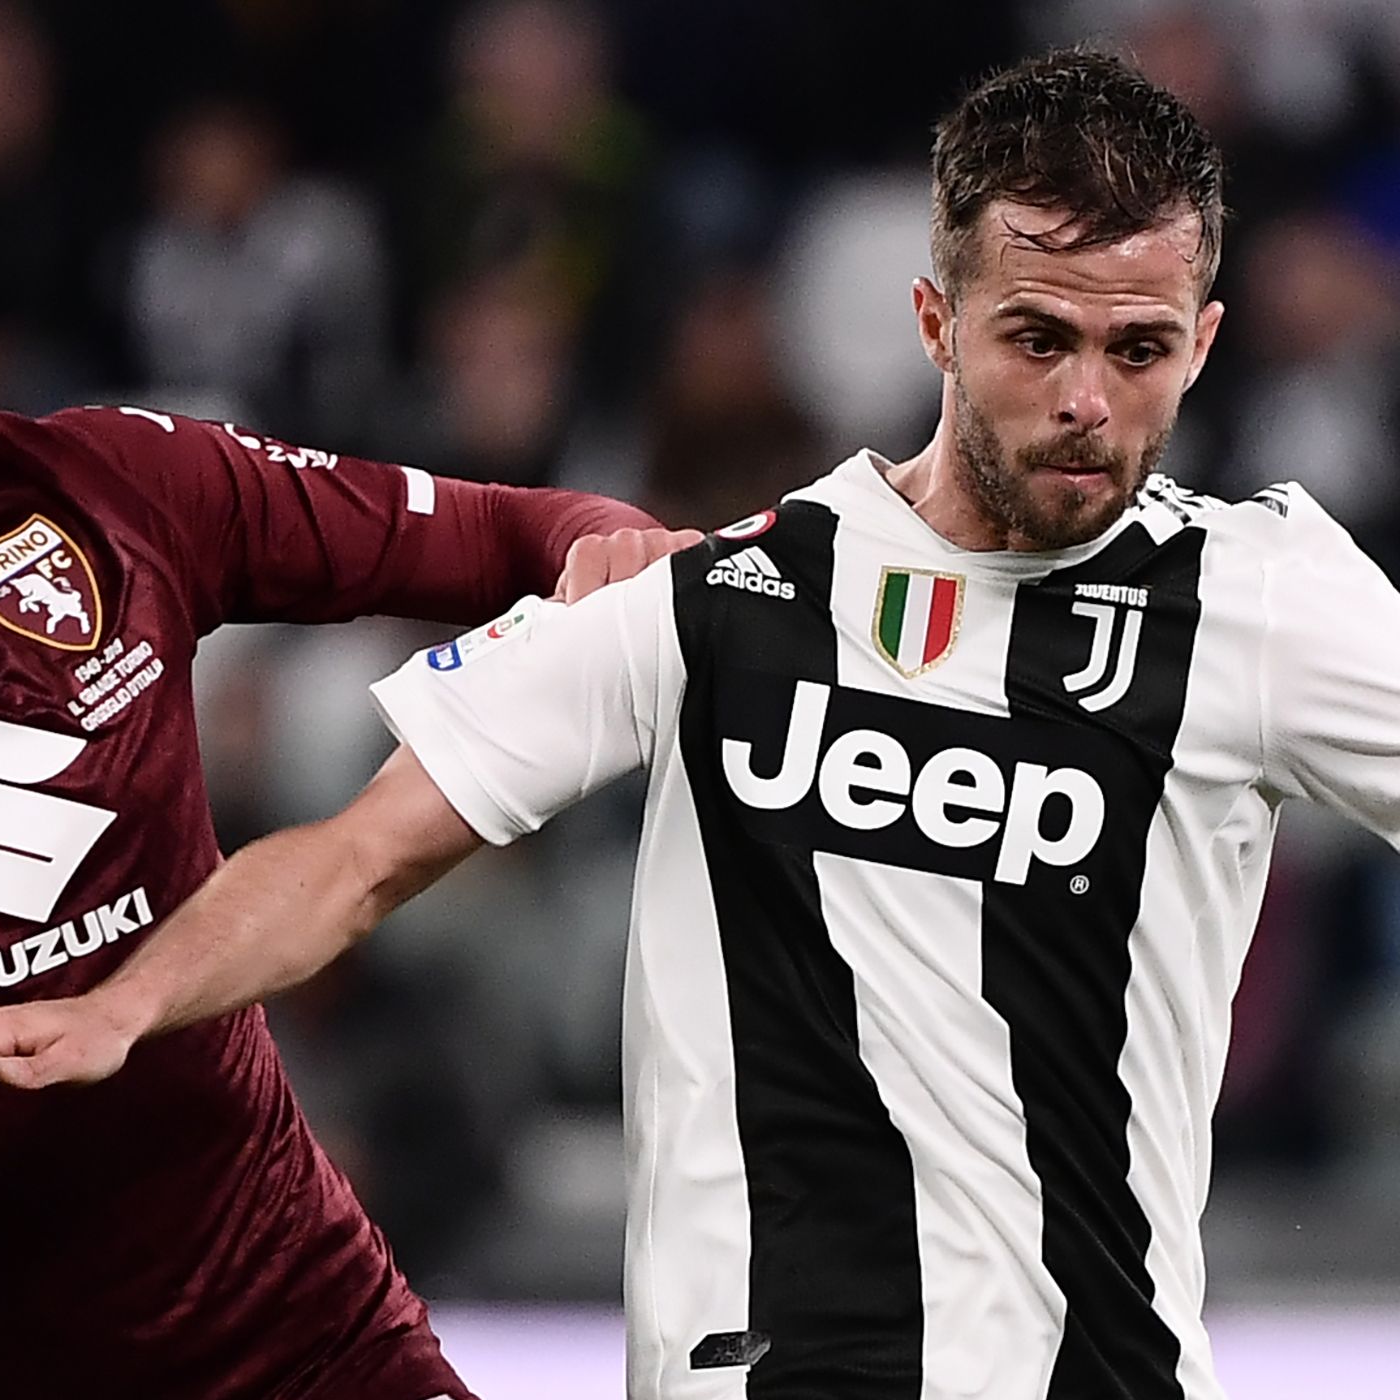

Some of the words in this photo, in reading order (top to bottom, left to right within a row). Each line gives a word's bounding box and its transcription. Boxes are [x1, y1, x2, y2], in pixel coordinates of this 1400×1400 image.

[35, 550, 73, 579] FC
[706, 568, 795, 600] adidas
[1074, 584, 1149, 607] JUVENTUS
[722, 680, 1105, 886] Jeep
